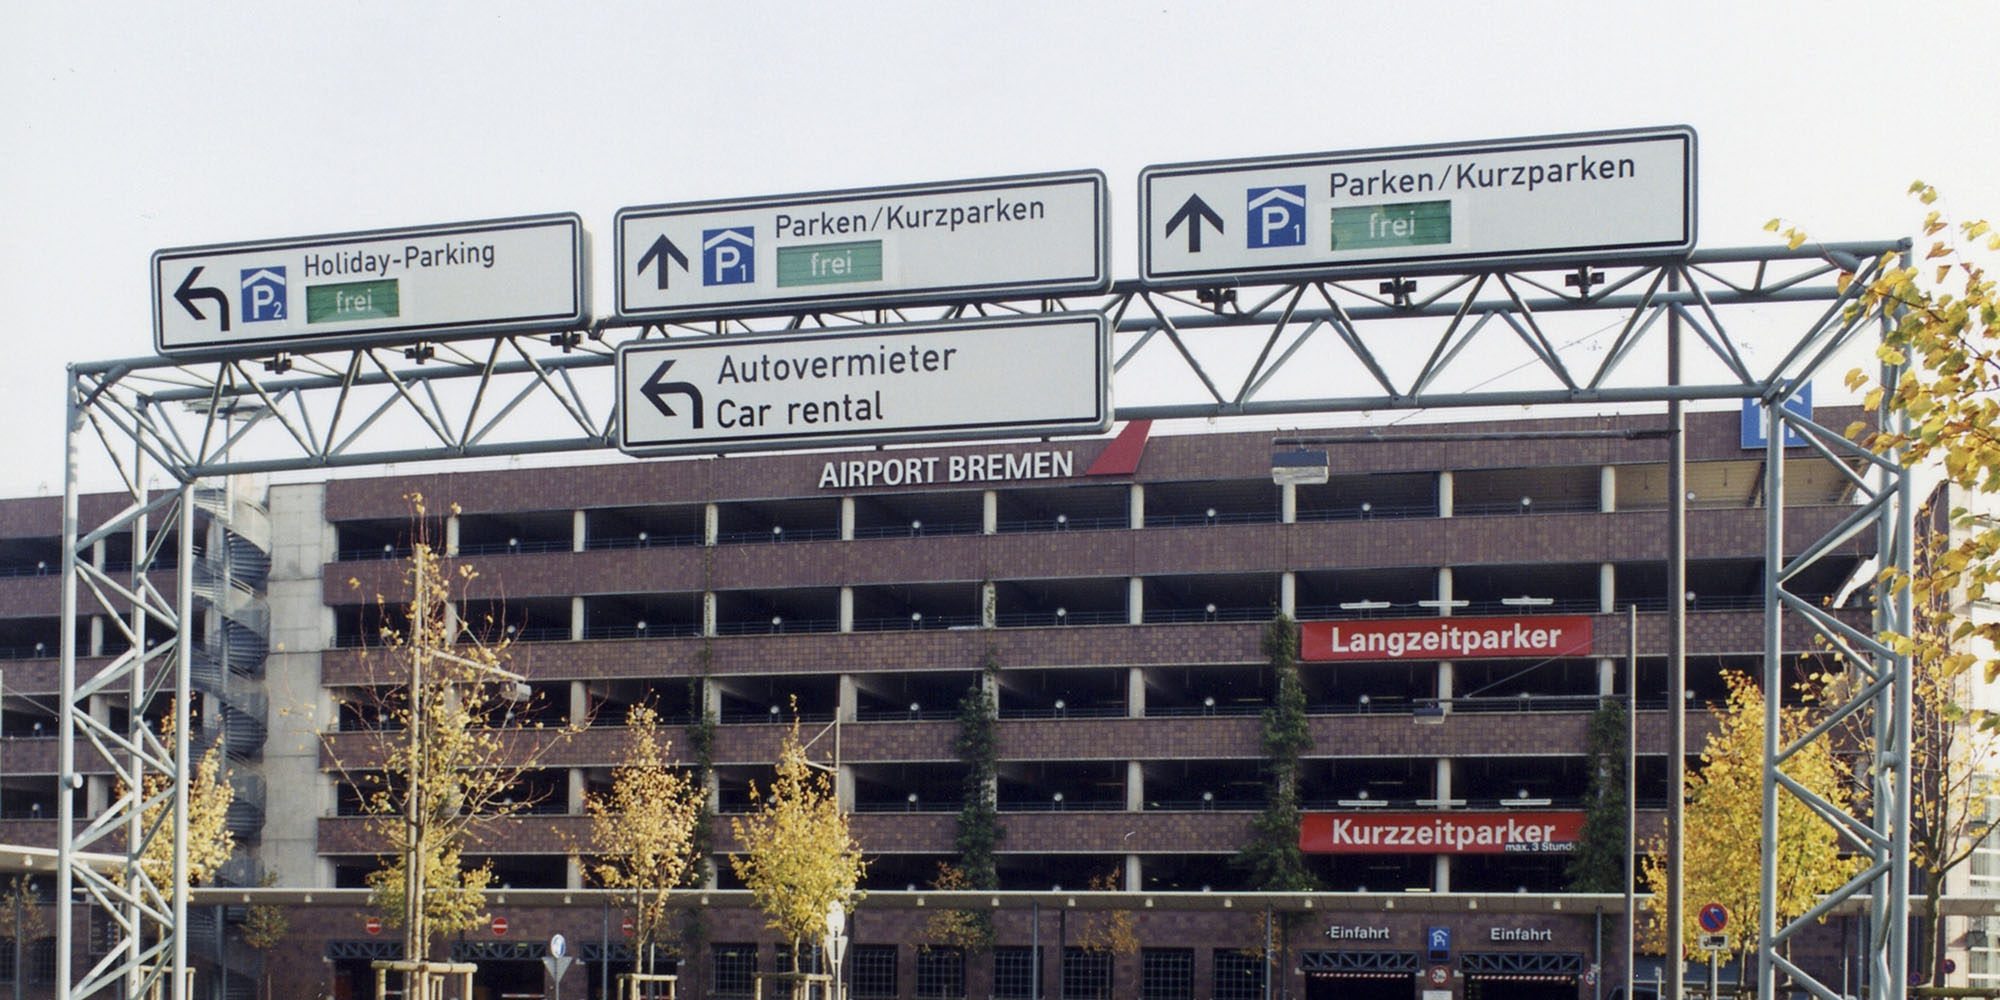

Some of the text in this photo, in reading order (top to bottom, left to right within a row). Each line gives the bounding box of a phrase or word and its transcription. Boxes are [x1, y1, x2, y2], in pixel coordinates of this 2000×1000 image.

[1330, 154, 1635, 198] Parken/Kurzparken
[775, 197, 1045, 239] Parken/Kurzparken
[1369, 211, 1415, 238] frei
[304, 241, 496, 278] Holiday-Parking
[810, 250, 852, 277] frei
[336, 288, 373, 313] frei
[717, 344, 957, 385] Autovermieter
[716, 391, 884, 429] Car rental
[819, 450, 1073, 489] AIRPORT BREMEN
[1331, 622, 1562, 656] Langzeitparker
[1332, 818, 1556, 851] Kurzzeitparker
[1505, 842, 1530, 852] max.
[1531, 841, 1540, 852] 3
[1490, 926, 1552, 942] Einfahrt
